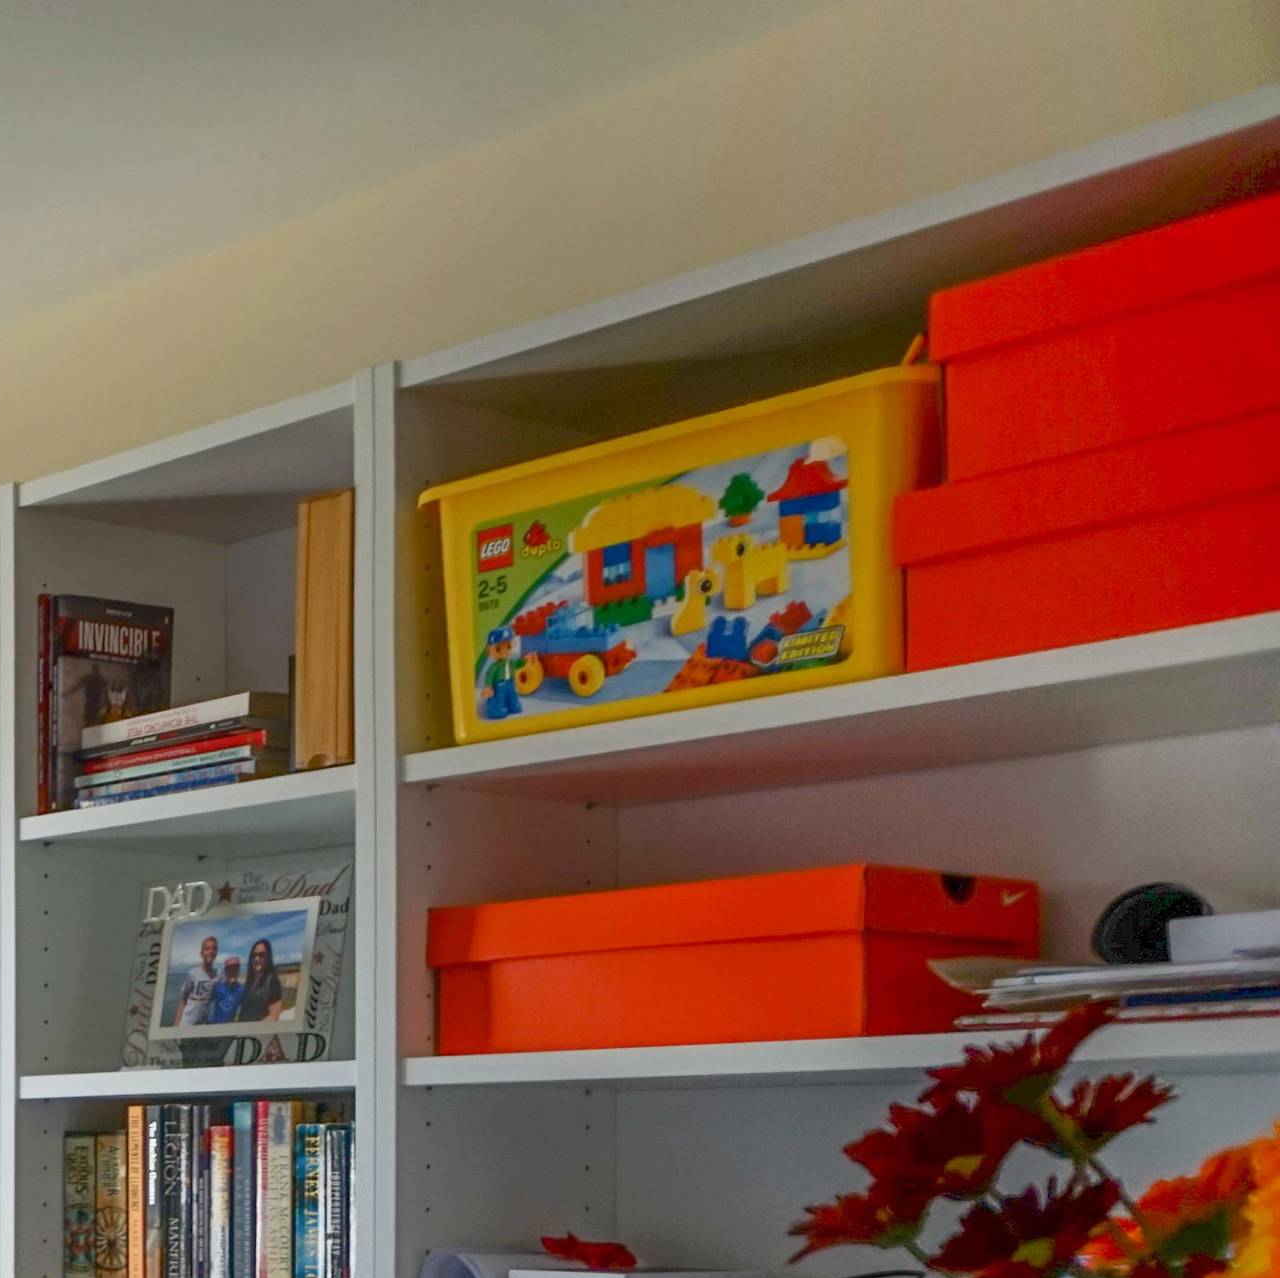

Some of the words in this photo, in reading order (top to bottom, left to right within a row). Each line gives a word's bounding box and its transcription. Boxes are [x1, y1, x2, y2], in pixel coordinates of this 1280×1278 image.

[479, 536, 511, 558] LEGO
[521, 538, 561, 559] duplo
[477, 576, 508, 598] 2-5
[79, 620, 160, 658] INVINCIBLE
[144, 880, 213, 923] DAD
[319, 897, 350, 916] Dad
[233, 1032, 326, 1066] DAD
[148, 1121, 157, 1137] The
[164, 1120, 180, 1196] LEGION
[305, 1136, 320, 1199] FERNEY
